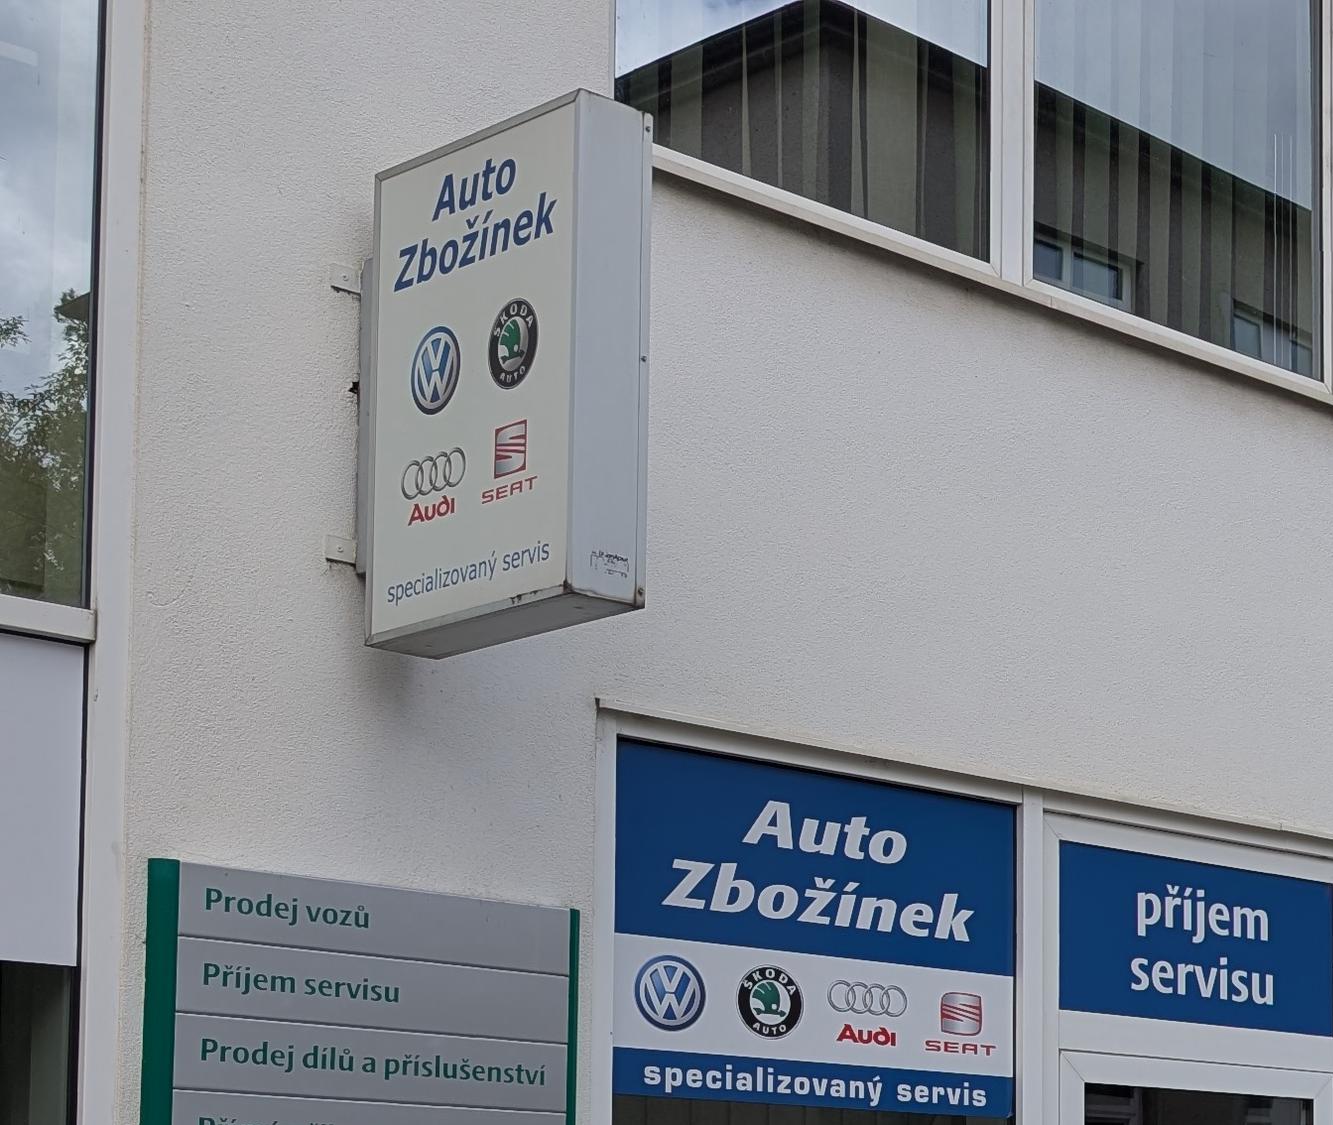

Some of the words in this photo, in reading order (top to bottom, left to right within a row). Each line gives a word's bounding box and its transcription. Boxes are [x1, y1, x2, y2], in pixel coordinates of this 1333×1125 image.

[432, 156, 517, 221] Auto
[393, 191, 557, 292] Zbožínek
[499, 366, 526, 384] AUTO
[408, 495, 456, 527] Audi
[481, 475, 538, 505] SEAT
[386, 550, 498, 605] specializovaný
[502, 539, 551, 576] servis
[742, 799, 908, 865] Auto
[204, 887, 299, 925] Prodej
[305, 904, 370, 929] vozů
[661, 858, 976, 943] Zbožínek
[1136, 884, 1269, 944] příjem
[202, 962, 296, 995] Příjem
[304, 976, 400, 1003] servisu
[742, 967, 797, 997] ŠKODA
[1130, 957, 1274, 1006] servisu
[752, 1020, 787, 1037] AUTO
[836, 1023, 897, 1047] Audi
[924, 1039, 997, 1057] SEAT
[200, 1038, 295, 1073] Prodej
[302, 1044, 354, 1072] dílů
[361, 1055, 376, 1073] a
[384, 1053, 546, 1086] příslušenství
[643, 1063, 882, 1107] specializovaný
[896, 1081, 988, 1108] servis
